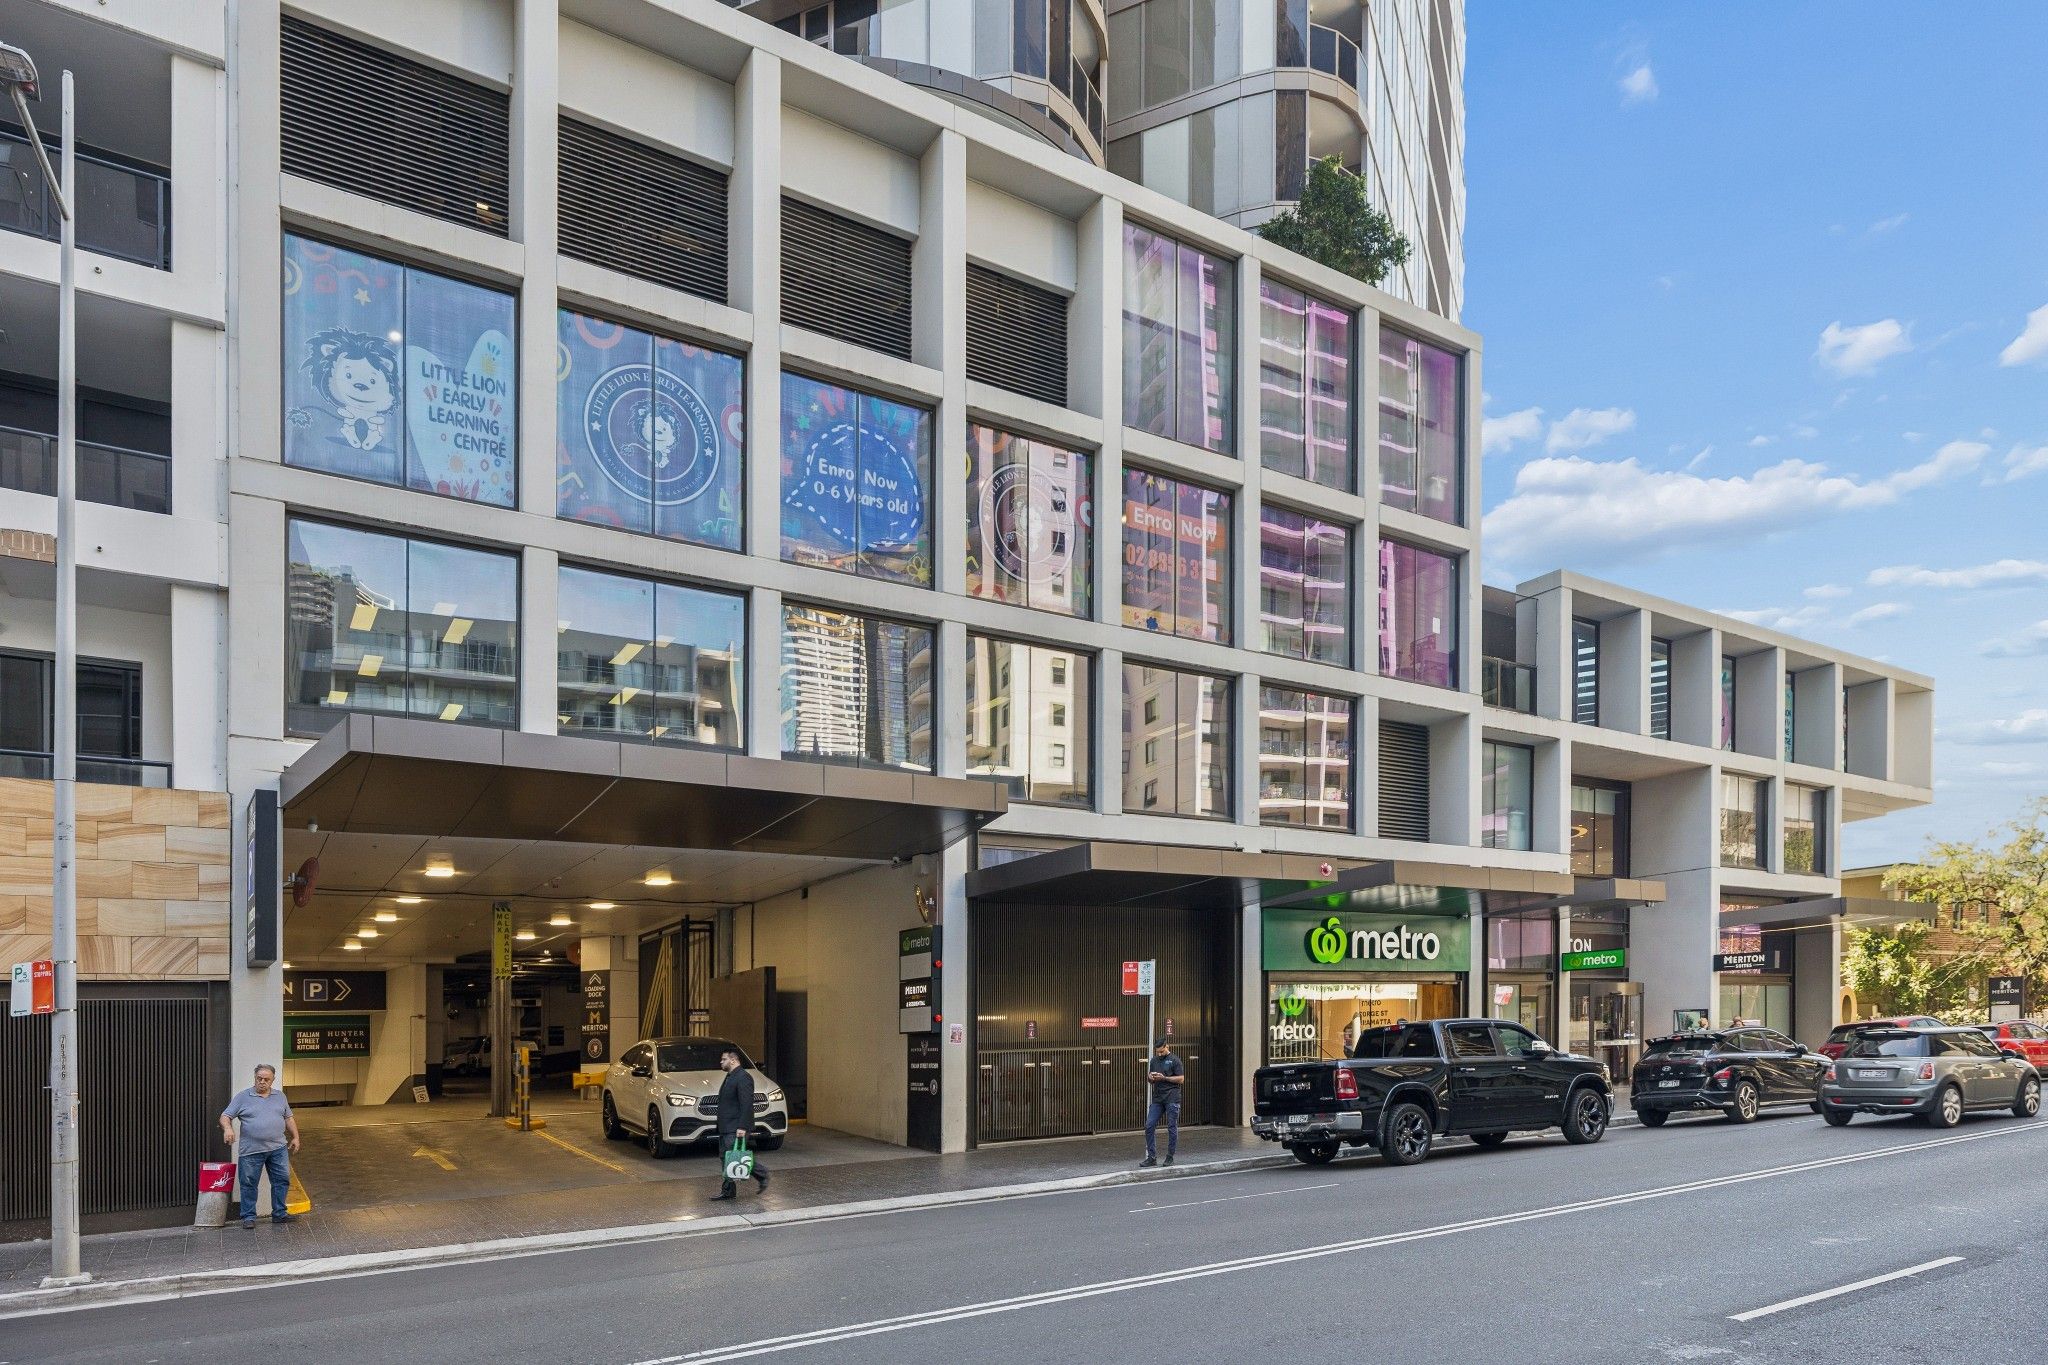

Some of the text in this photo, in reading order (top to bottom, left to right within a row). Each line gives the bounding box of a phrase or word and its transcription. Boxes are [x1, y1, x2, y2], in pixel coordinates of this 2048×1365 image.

[421, 361, 506, 397] LITTLE LION
[443, 387, 486, 413] EARLY
[592, 381, 616, 417] LITTLE
[614, 372, 641, 387] LION
[677, 388, 713, 444] LEARNING
[428, 405, 499, 436] LEARNING
[453, 432, 507, 458] CENTRE
[864, 468, 898, 491] Now
[814, 480, 840, 499] 0-6
[887, 498, 908, 515] old
[1181, 518, 1216, 543] Now
[1126, 543, 1145, 567] 02
[910, 936, 930, 949] metro
[1352, 924, 1440, 960] metro
[1583, 954, 1617, 966] metro
[1723, 955, 1765, 965] MERITON
[309, 983, 323, 998] P
[905, 985, 927, 995] MERITON
[1270, 1019, 1316, 1040] metro
